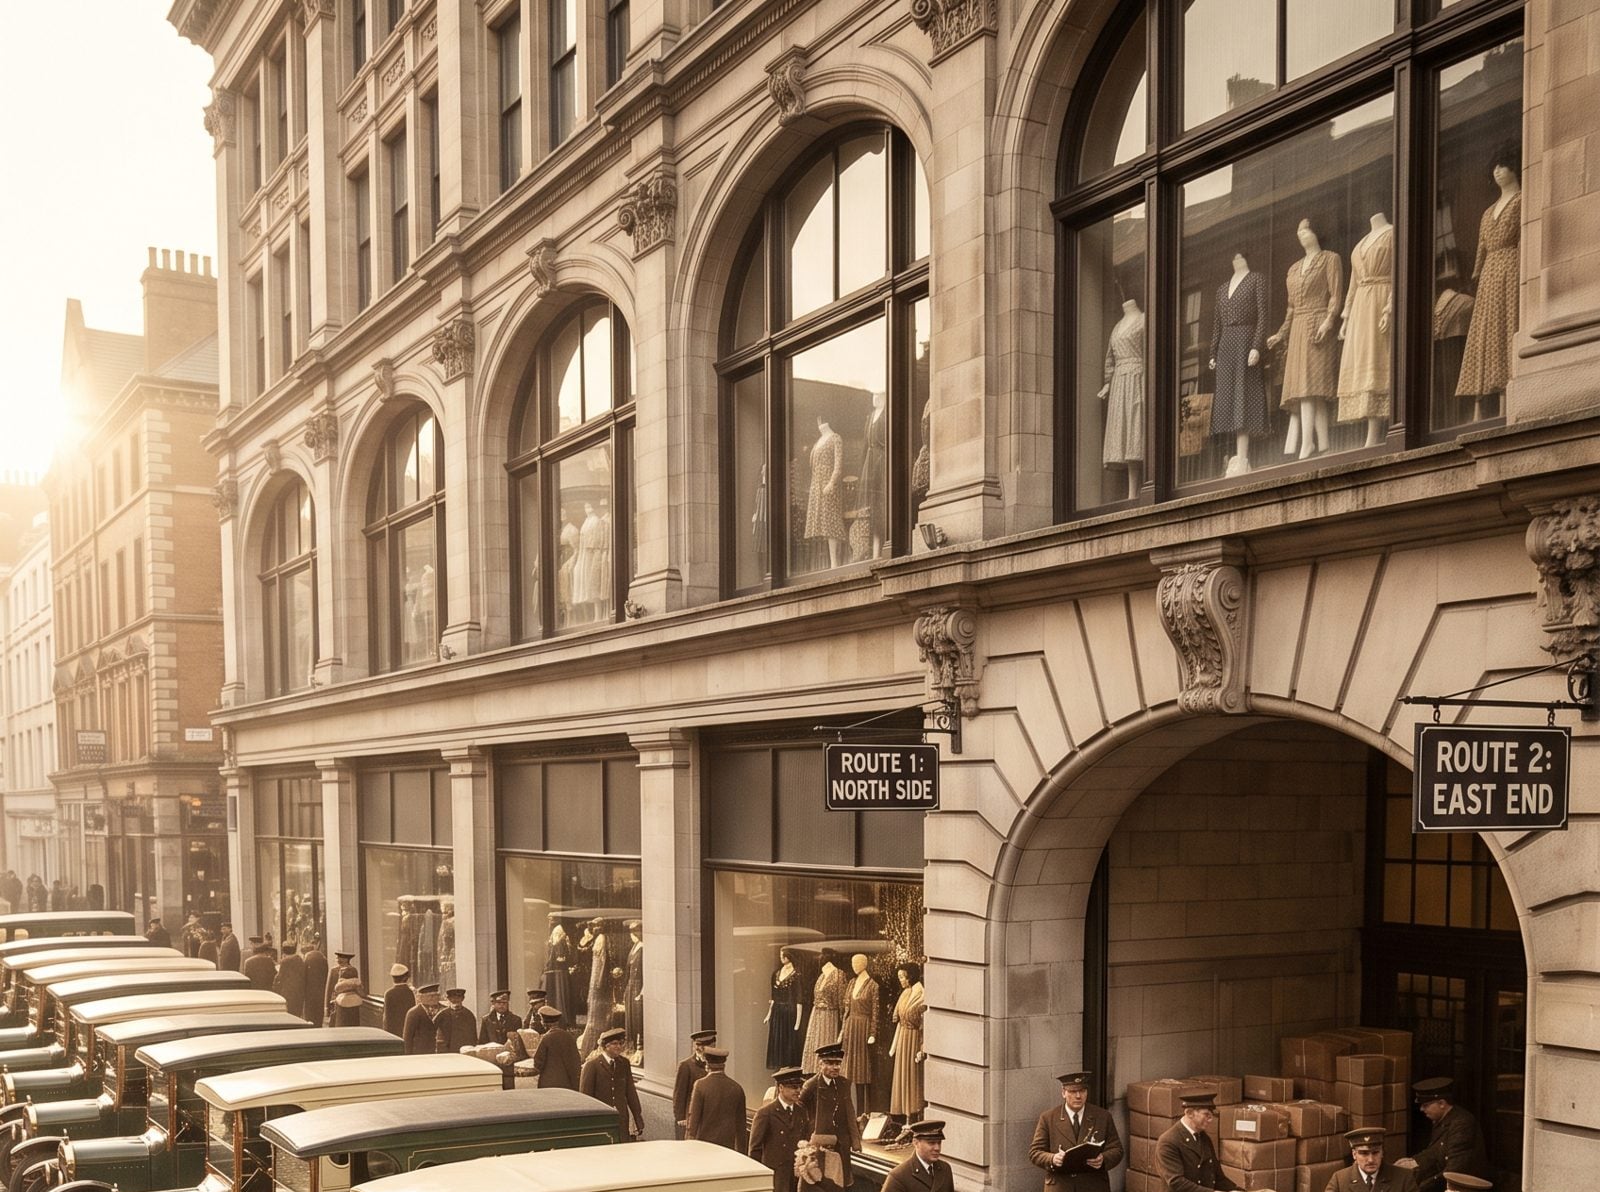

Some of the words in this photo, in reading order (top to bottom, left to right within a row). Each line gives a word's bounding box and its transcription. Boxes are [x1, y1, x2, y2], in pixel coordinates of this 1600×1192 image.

[841, 753, 902, 773] ROUTE
[909, 753, 924, 773] 1:
[1437, 740, 1519, 773] ROUTE
[1528, 742, 1552, 774] 2:
[832, 779, 890, 801] NORTH
[895, 779, 933, 801] SIDE
[1433, 783, 1497, 815] EAST
[1506, 783, 1554, 815] END
